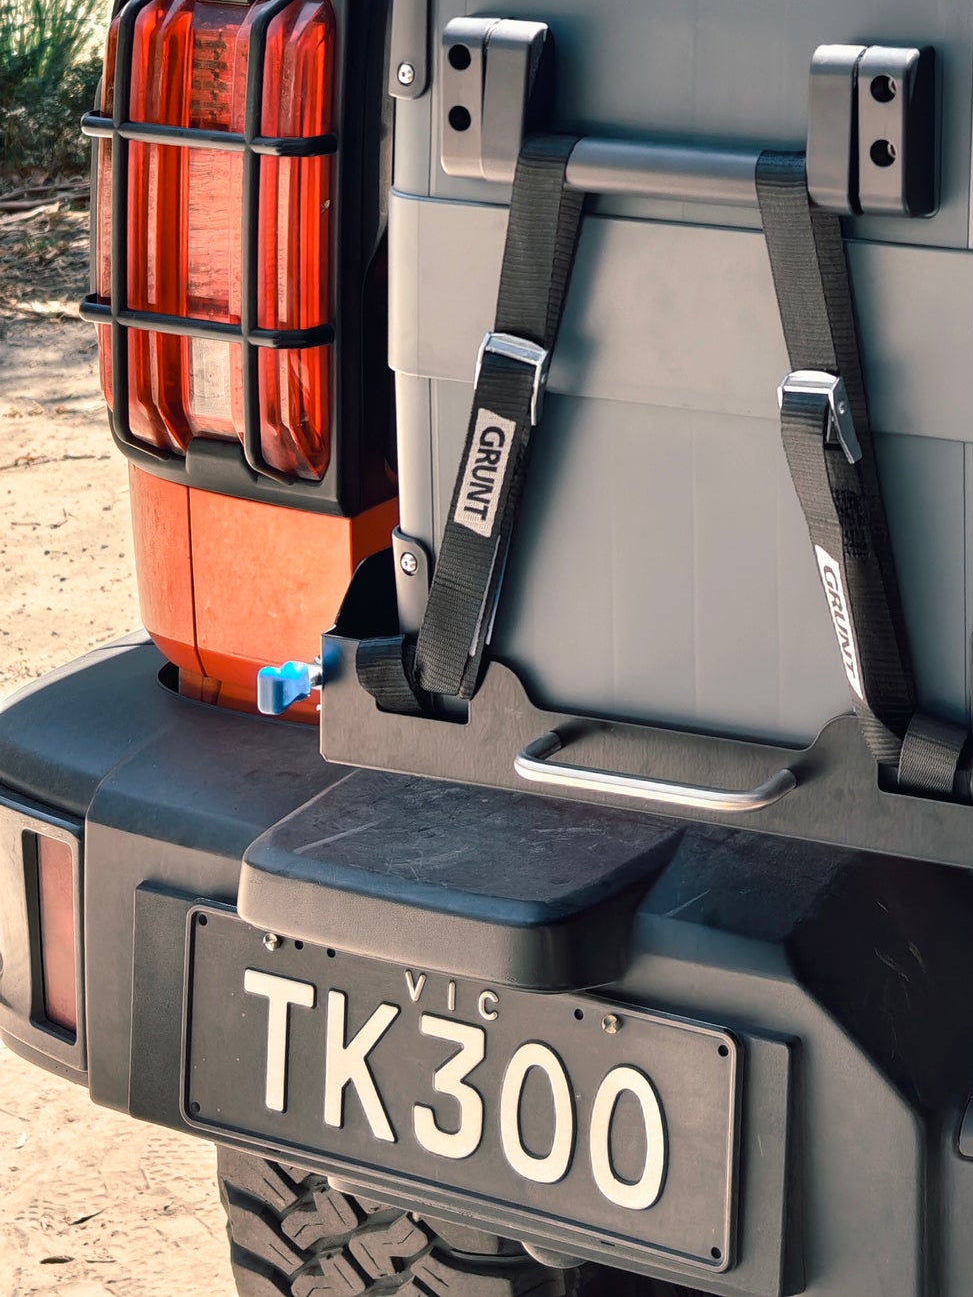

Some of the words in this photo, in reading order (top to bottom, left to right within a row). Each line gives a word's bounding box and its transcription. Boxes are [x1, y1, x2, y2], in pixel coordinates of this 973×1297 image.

[463, 426, 506, 521] GRUNT
[823, 565, 856, 679] GRUNT
[404, 969, 500, 1021] VIC
[243, 967, 668, 1211] TK300
